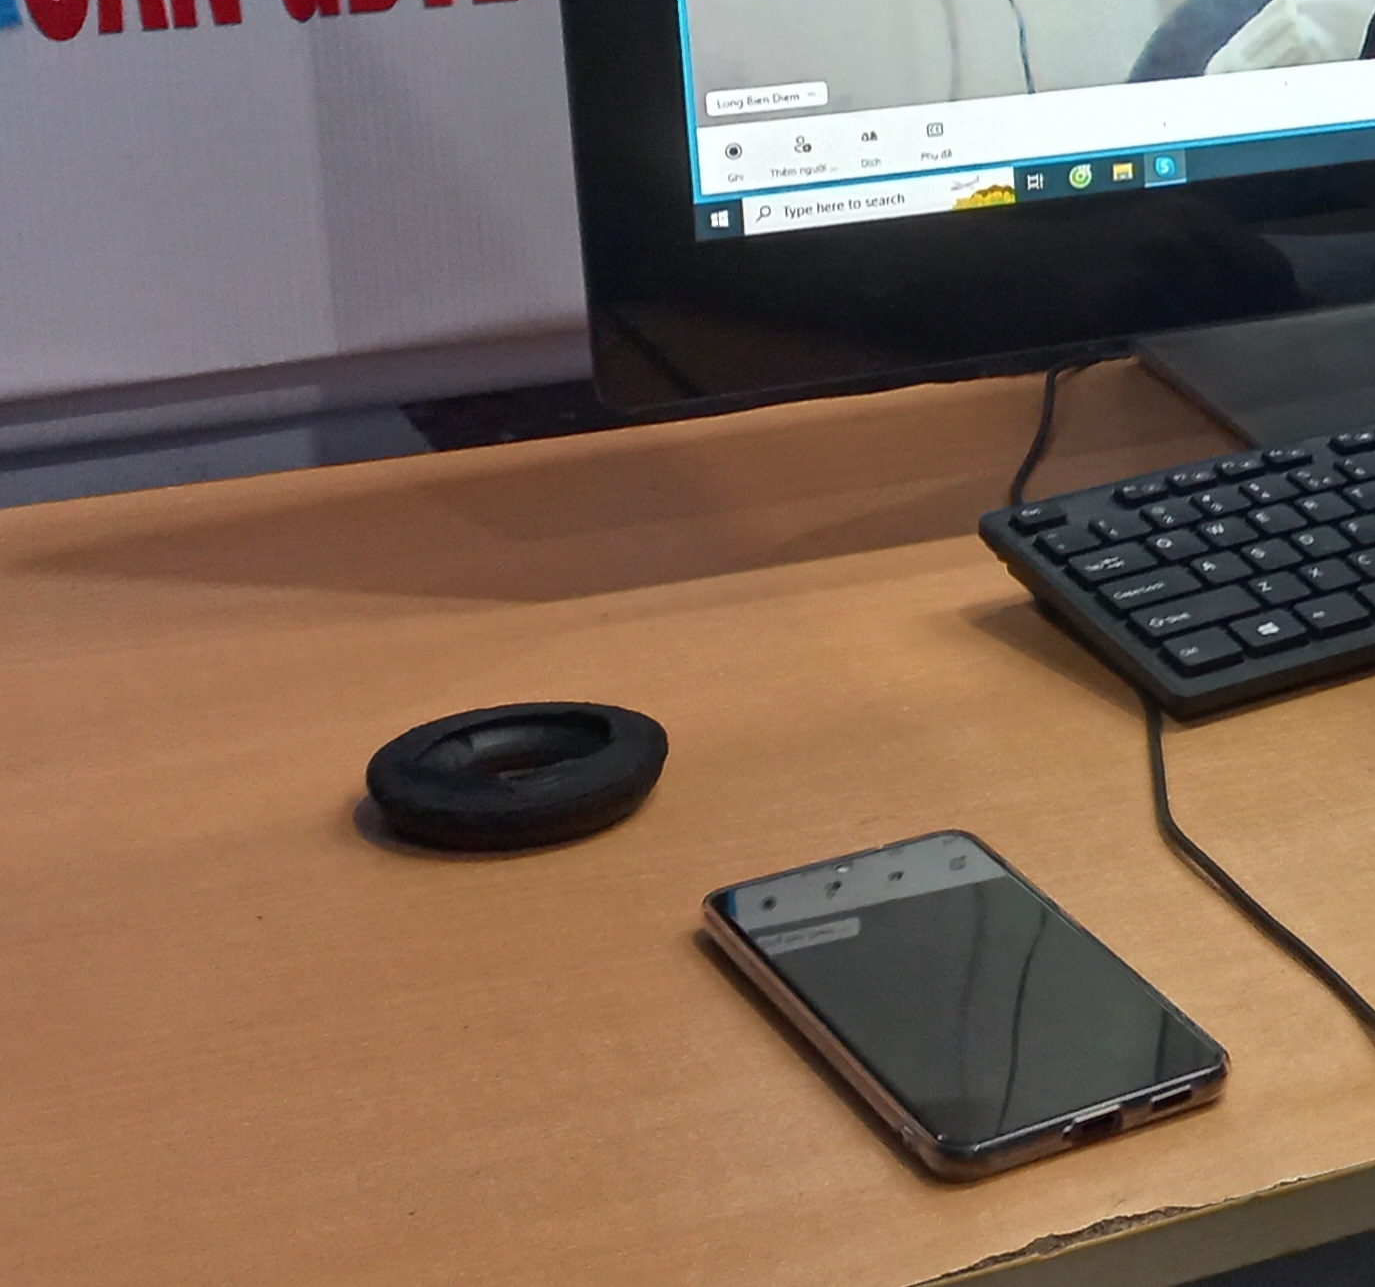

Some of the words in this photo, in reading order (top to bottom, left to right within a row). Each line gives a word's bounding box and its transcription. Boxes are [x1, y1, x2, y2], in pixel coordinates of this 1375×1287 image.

[716, 96, 744, 110] Long
[783, 204, 813, 219] Type
[816, 199, 846, 213] here
[848, 198, 862, 209] to
[865, 193, 906, 208] search
[1358, 554, 1372, 565] C
[1257, 580, 1273, 592] Z
